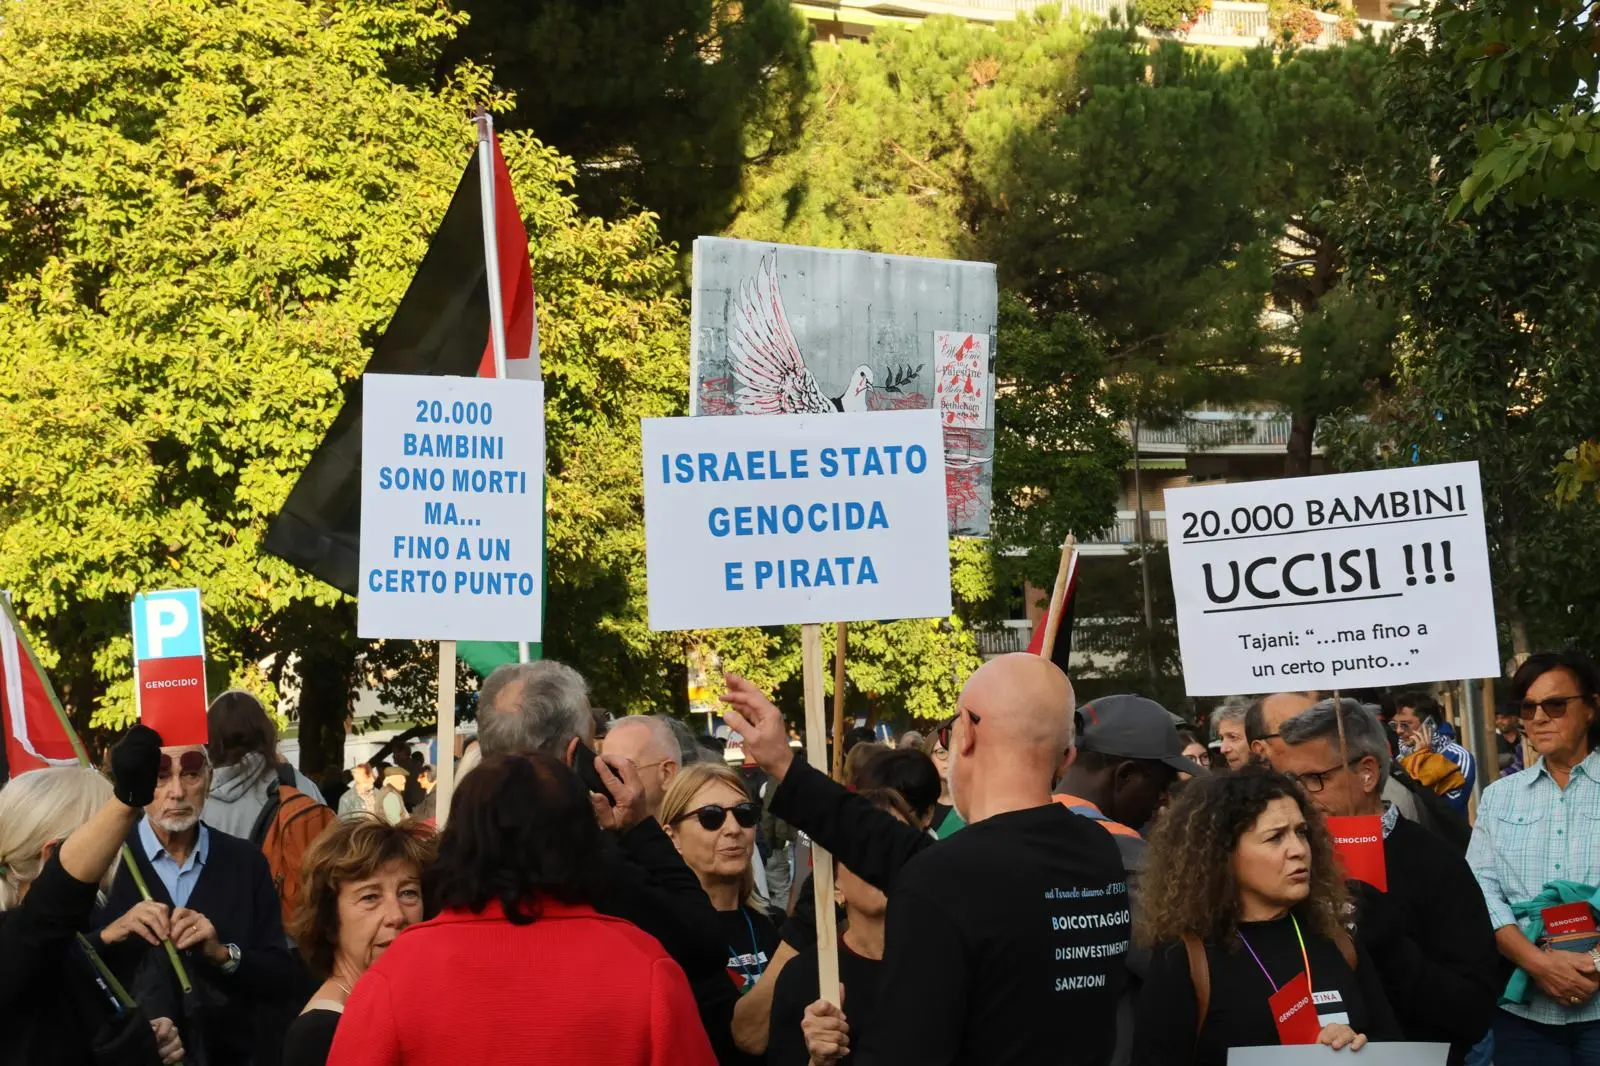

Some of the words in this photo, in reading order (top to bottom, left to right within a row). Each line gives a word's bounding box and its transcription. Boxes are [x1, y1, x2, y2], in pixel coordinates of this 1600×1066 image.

[416, 400, 492, 425] 20.000
[403, 432, 504, 461] BAMBINI
[662, 448, 809, 485] ISRAELE
[820, 443, 927, 478] STATO
[379, 466, 446, 492] SONO
[452, 468, 526, 494] MORTI
[424, 501, 481, 527] MA...
[708, 500, 890, 537] GENOCIDA
[1182, 502, 1294, 539] 20.000
[1305, 484, 1466, 527] BAMBINI
[393, 535, 449, 560] FINO
[456, 537, 471, 561] A
[478, 538, 511, 562] UN
[368, 569, 447, 594] CERTO
[454, 571, 534, 596] PUNTO
[725, 561, 744, 591] E
[754, 556, 878, 590] PIRATA
[1201, 547, 1382, 604] UCCISI
[1402, 540, 1455, 586] !!!
[145, 598, 189, 658] P
[1238, 632, 1300, 652] Tajani:
[1372, 623, 1410, 640] fino
[1417, 623, 1428, 636] a
[1252, 662, 1275, 677] un
[1281, 656, 1325, 675] certo
[145, 678, 198, 689] GENOCIDIO
[1052, 909, 1130, 931] BOICOTTAGGIO
[1550, 916, 1587, 927] GENOCIDIO
[1055, 974, 1106, 992] SANZIONI
[1279, 996, 1309, 1023] GENOCIDIO
[1312, 992, 1338, 1002] TINA
